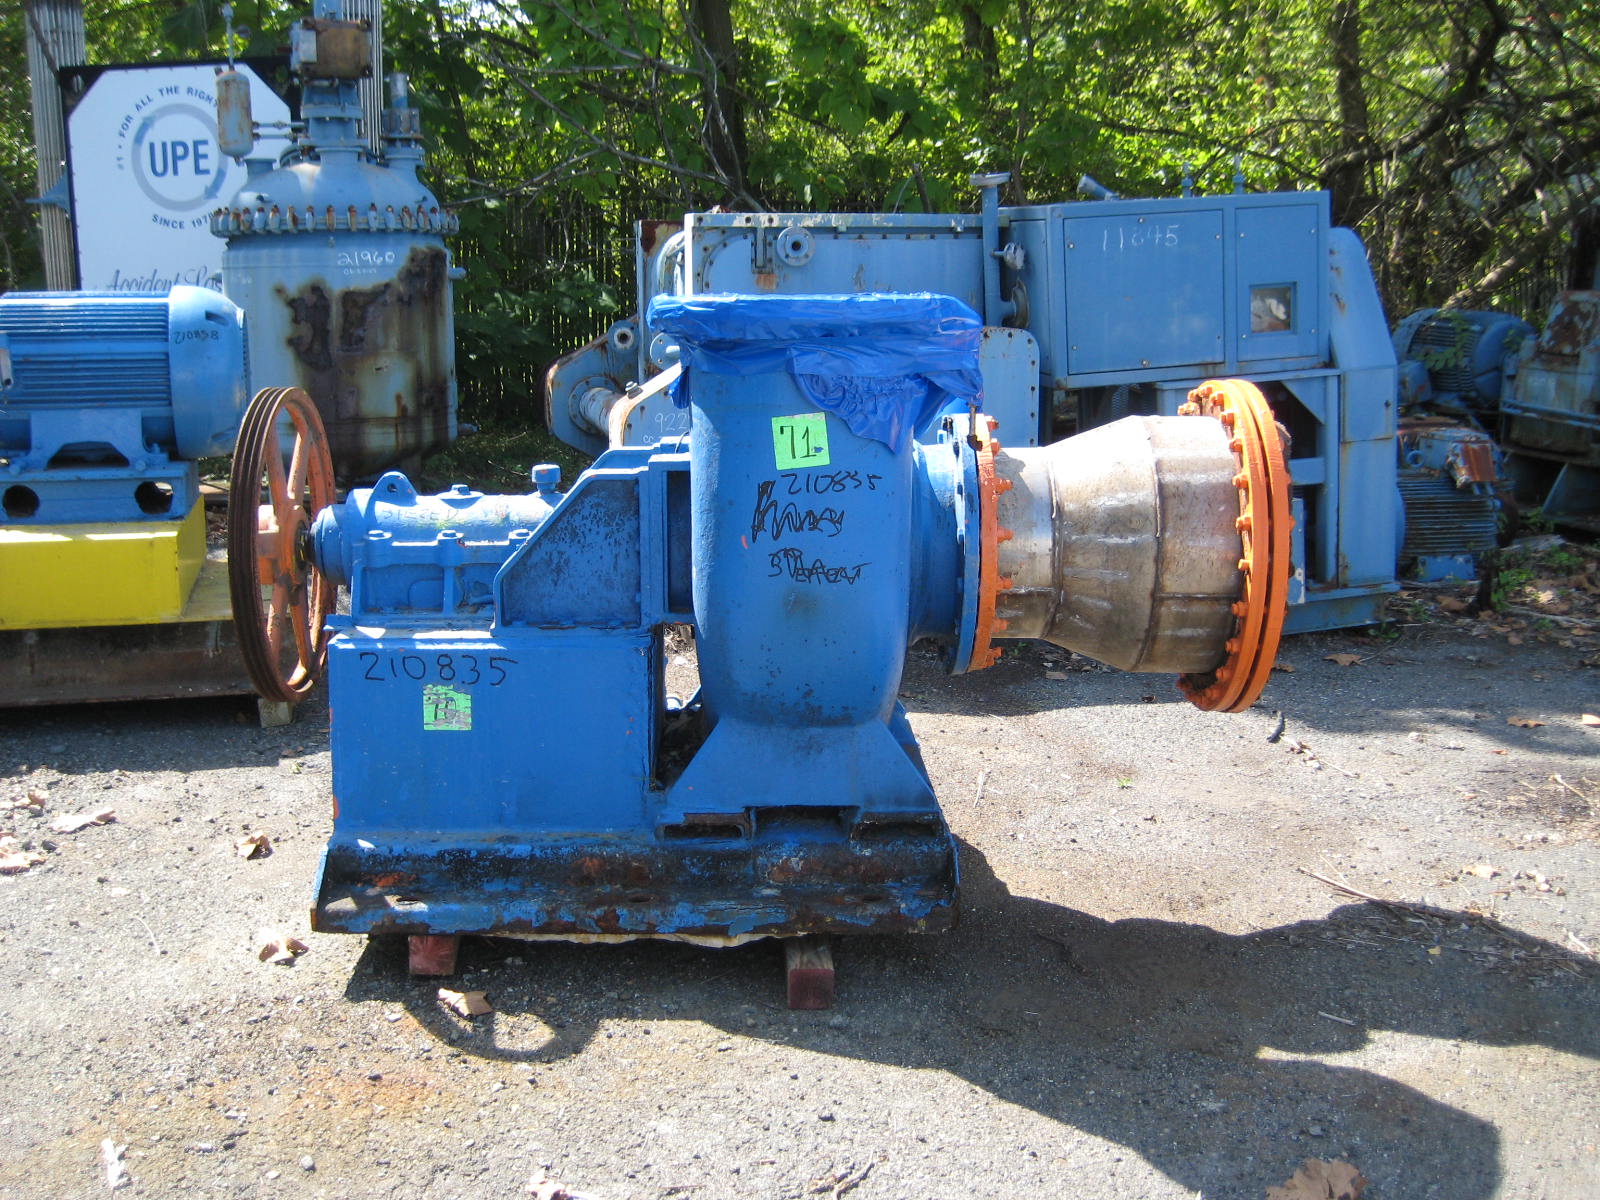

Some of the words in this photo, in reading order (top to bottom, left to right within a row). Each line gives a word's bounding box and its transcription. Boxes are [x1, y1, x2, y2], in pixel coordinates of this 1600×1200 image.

[118, 115, 134, 139] FOR
[135, 95, 154, 112] ALL
[158, 85, 180, 97] THE
[149, 139, 211, 178] UPE
[152, 213, 185, 230] SINCE
[337, 250, 396, 266] 21960
[779, 425, 817, 460] 71
[359, 652, 518, 686] 210835
